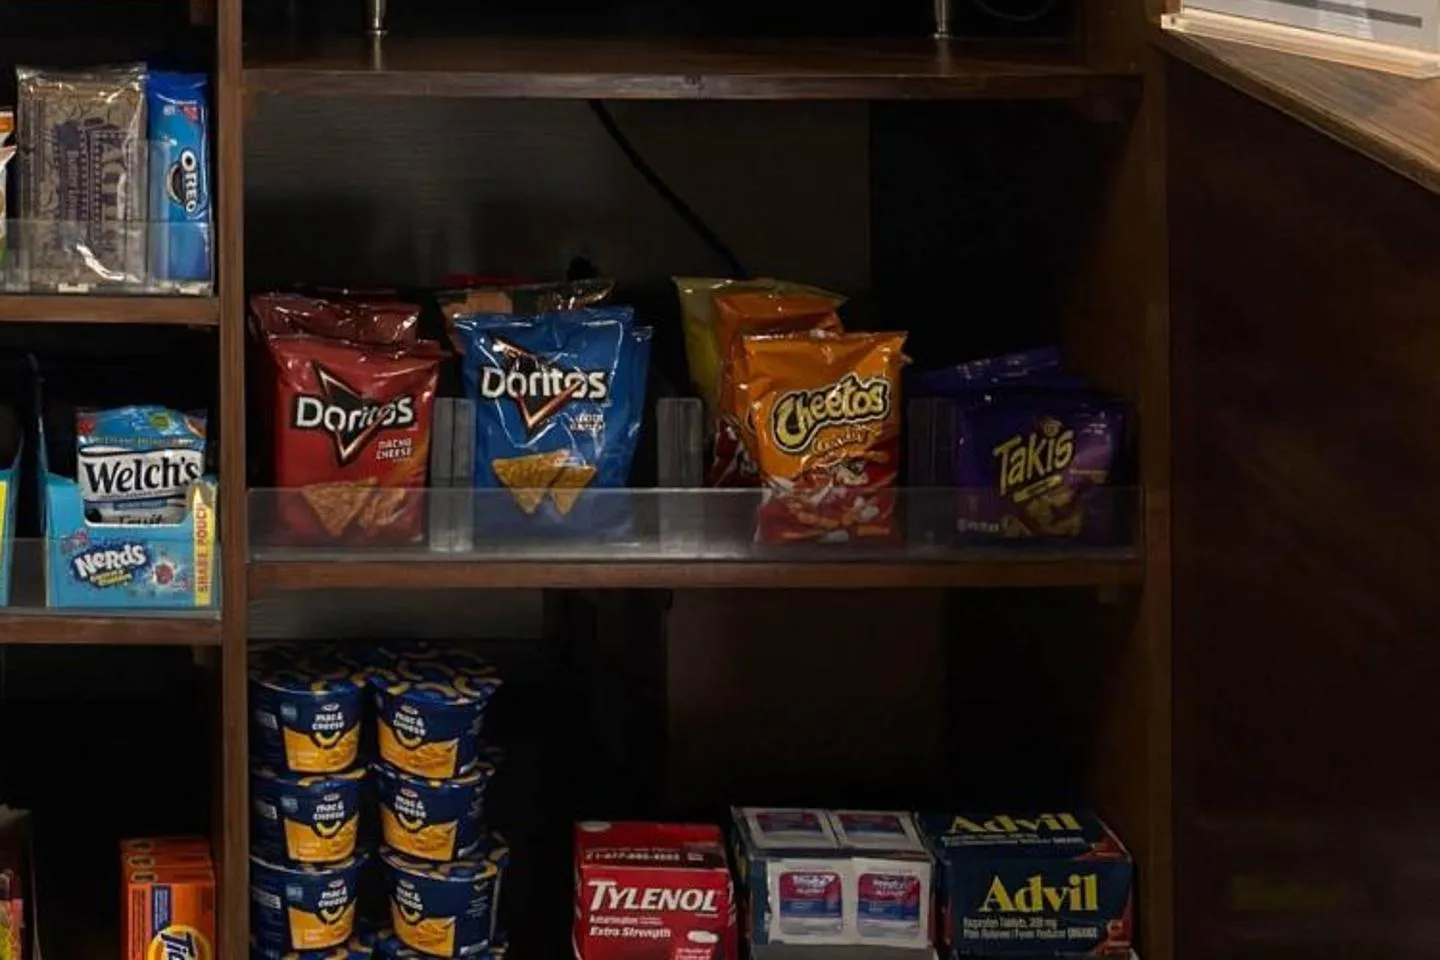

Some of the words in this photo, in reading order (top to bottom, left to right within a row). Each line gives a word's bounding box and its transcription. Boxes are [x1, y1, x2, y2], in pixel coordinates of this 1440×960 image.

[180, 149, 198, 213] OREO
[481, 366, 608, 400] Doritos
[296, 396, 414, 432] Doritos
[776, 379, 886, 447] Cheetos
[83, 456, 199, 494] Welch's
[992, 430, 1075, 497] Takis
[948, 813, 1083, 834] Advil
[587, 880, 718, 912] TYLENOL
[977, 874, 1099, 912] Advil
[589, 927, 620, 938] Extra
[622, 927, 672, 939] Strength
